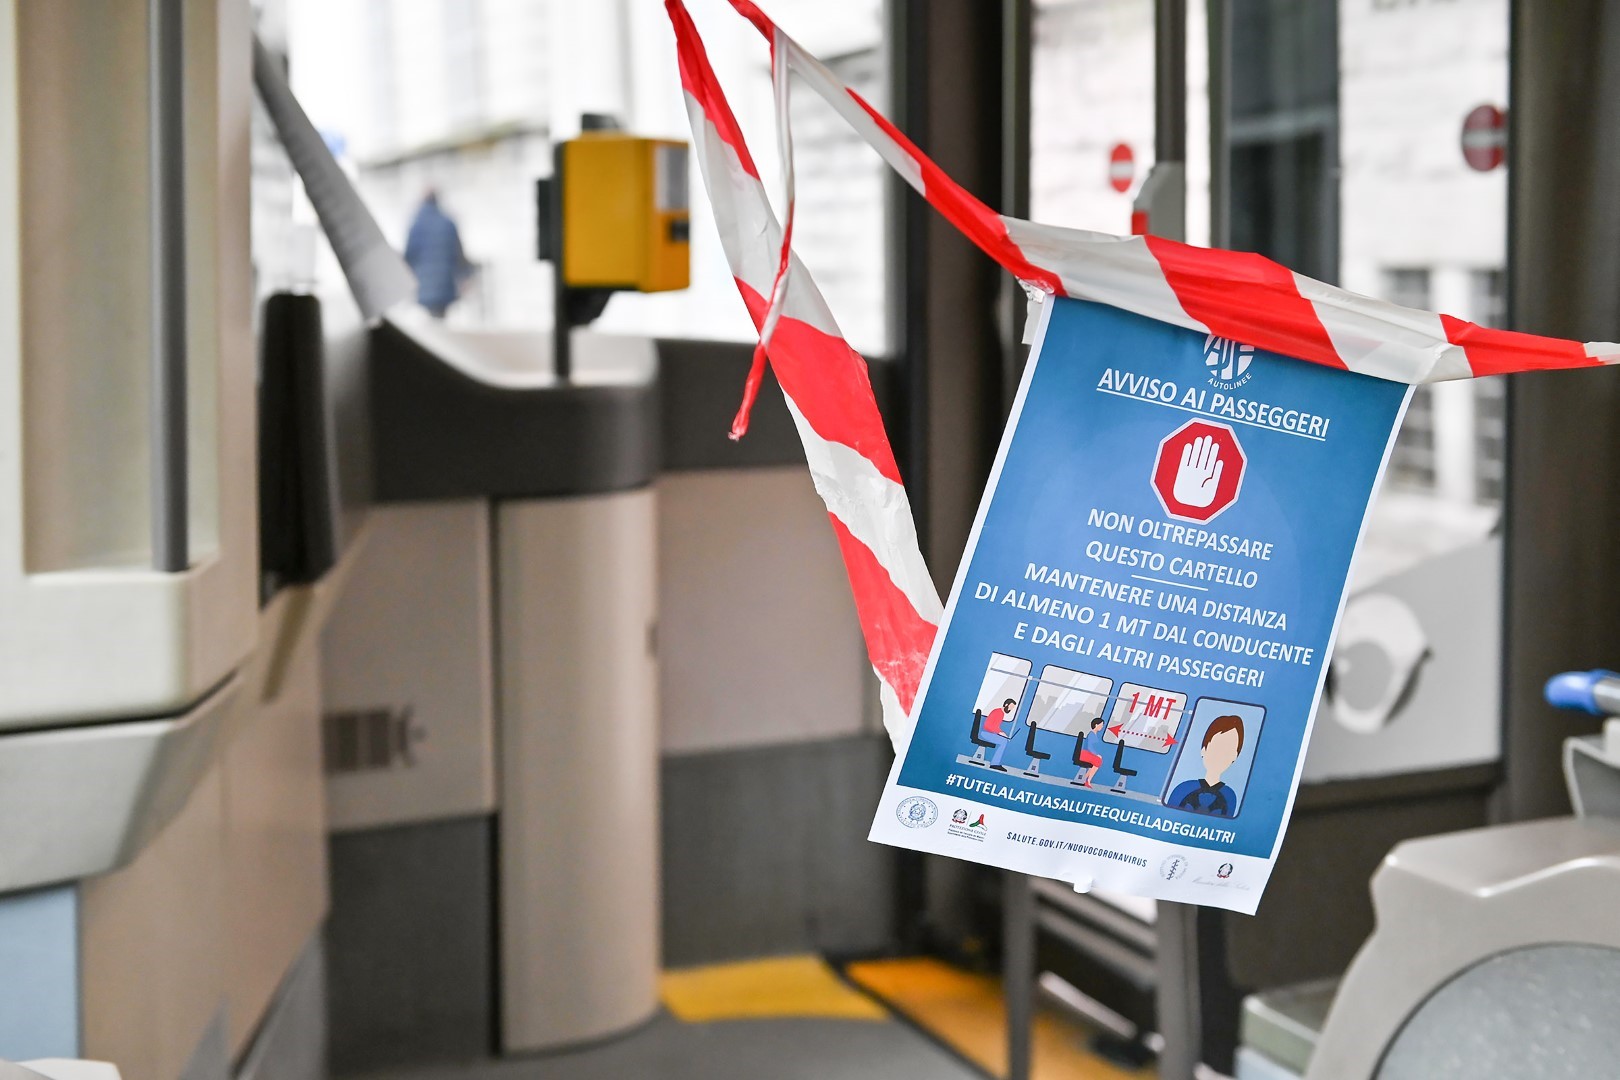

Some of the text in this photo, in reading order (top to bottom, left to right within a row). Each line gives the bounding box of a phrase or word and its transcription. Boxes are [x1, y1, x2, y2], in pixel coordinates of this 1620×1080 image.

[1098, 368, 1330, 438] AVVISO AI PASSEGGERI
[1207, 372, 1252, 390] AUTOLINEE
[1088, 508, 1273, 561] NON OLTREPASSARE
[1085, 540, 1258, 589] QUESTO CARTELLO
[974, 582, 1314, 666] DI ALMENO 1 MT DAL CONDUCENTE
[1024, 562, 1287, 631] MANTENERE UNA DISTANZA
[1013, 622, 1265, 688] E DAGLI ALTRI PASSEGGERI
[1129, 692, 1177, 720] 1 MT
[945, 773, 1236, 844] #TUTELALATUASALUTEEQUELLADEGLIALTRI
[1006, 831, 1148, 868] SALUTE.GOV.IT/NUOVOCORONAVIRUS
